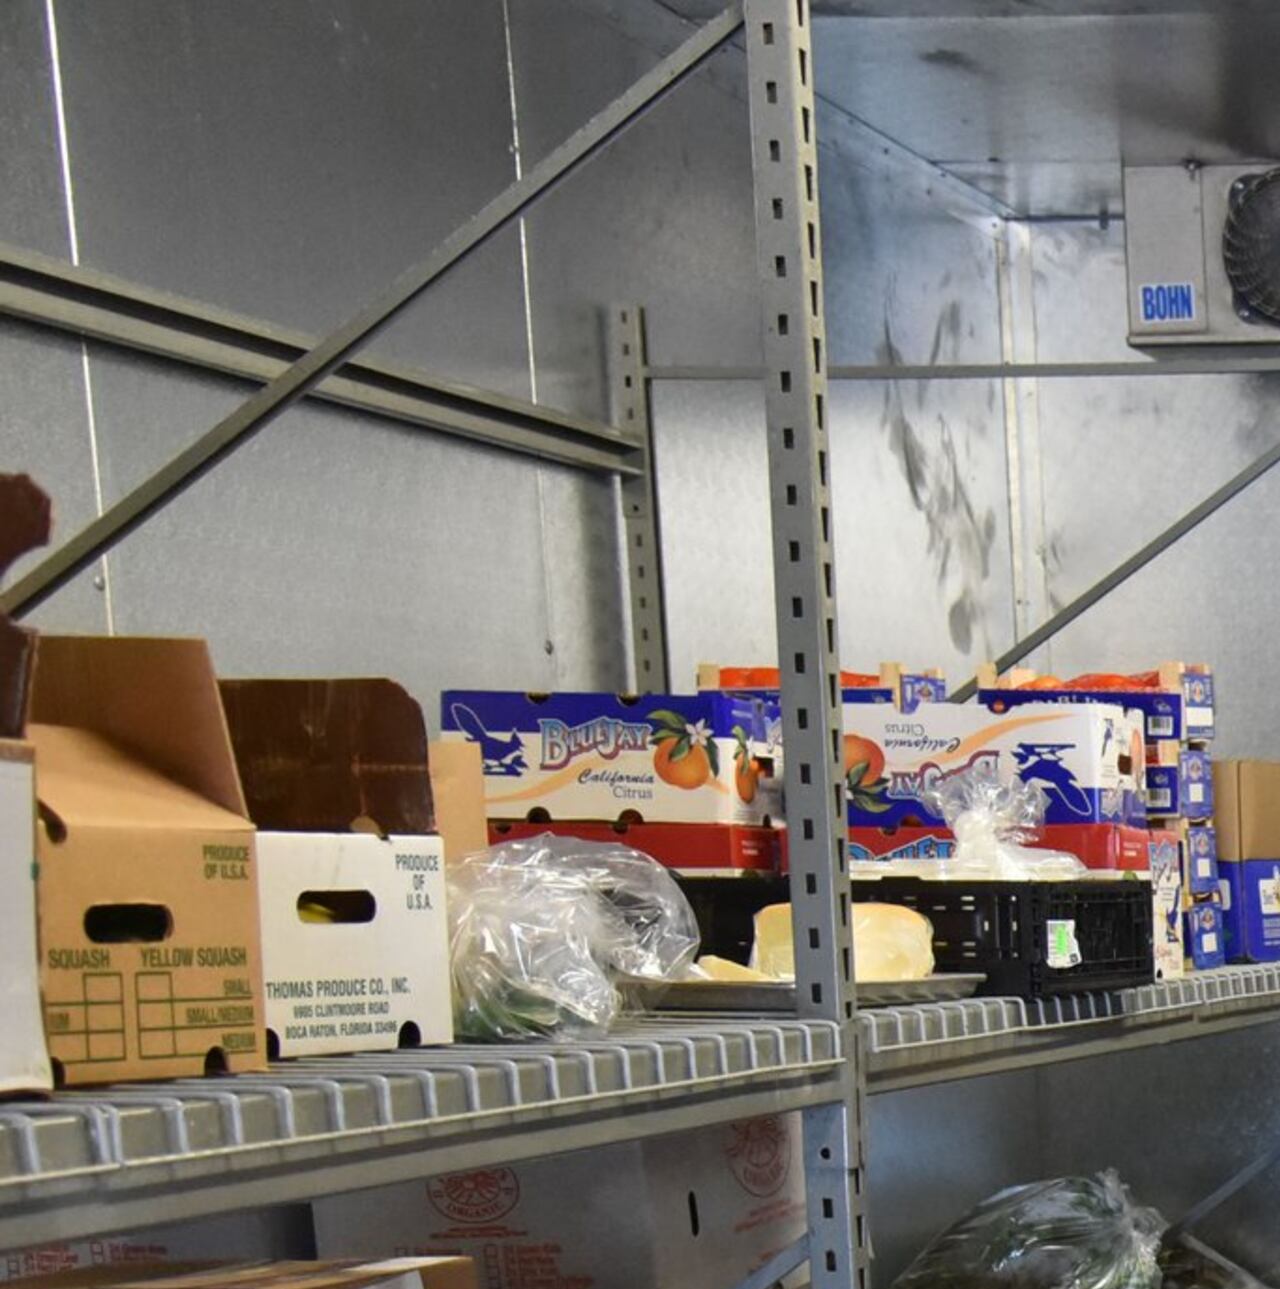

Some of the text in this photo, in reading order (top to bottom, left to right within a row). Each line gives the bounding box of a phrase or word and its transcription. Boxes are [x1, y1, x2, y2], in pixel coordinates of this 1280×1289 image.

[1143, 285, 1193, 321] BOHN
[884, 724, 925, 736] Citrus
[884, 737, 961, 753] California
[578, 768, 654, 785] California
[613, 785, 653, 799] Citrus
[203, 845, 249, 861] PRODUCE
[395, 854, 439, 871] PRODUCE
[205, 865, 217, 879] OF
[413, 874, 424, 890] OF
[406, 894, 432, 910] U.S.A.
[49, 949, 110, 968] SQUASH
[140, 948, 246, 967] YELLOW SQUASH
[223, 979, 250, 996] SMALL
[266, 981, 313, 998] THOMAS
[317, 980, 366, 997] PRODUCE
[391, 977, 410, 993] INC.
[315, 1003, 366, 1018] CLINTMOORE
[369, 1002, 388, 1015] ROAD
[286, 1026, 306, 1039] BOCA
[340, 1022, 372, 1036] FLORIDA
